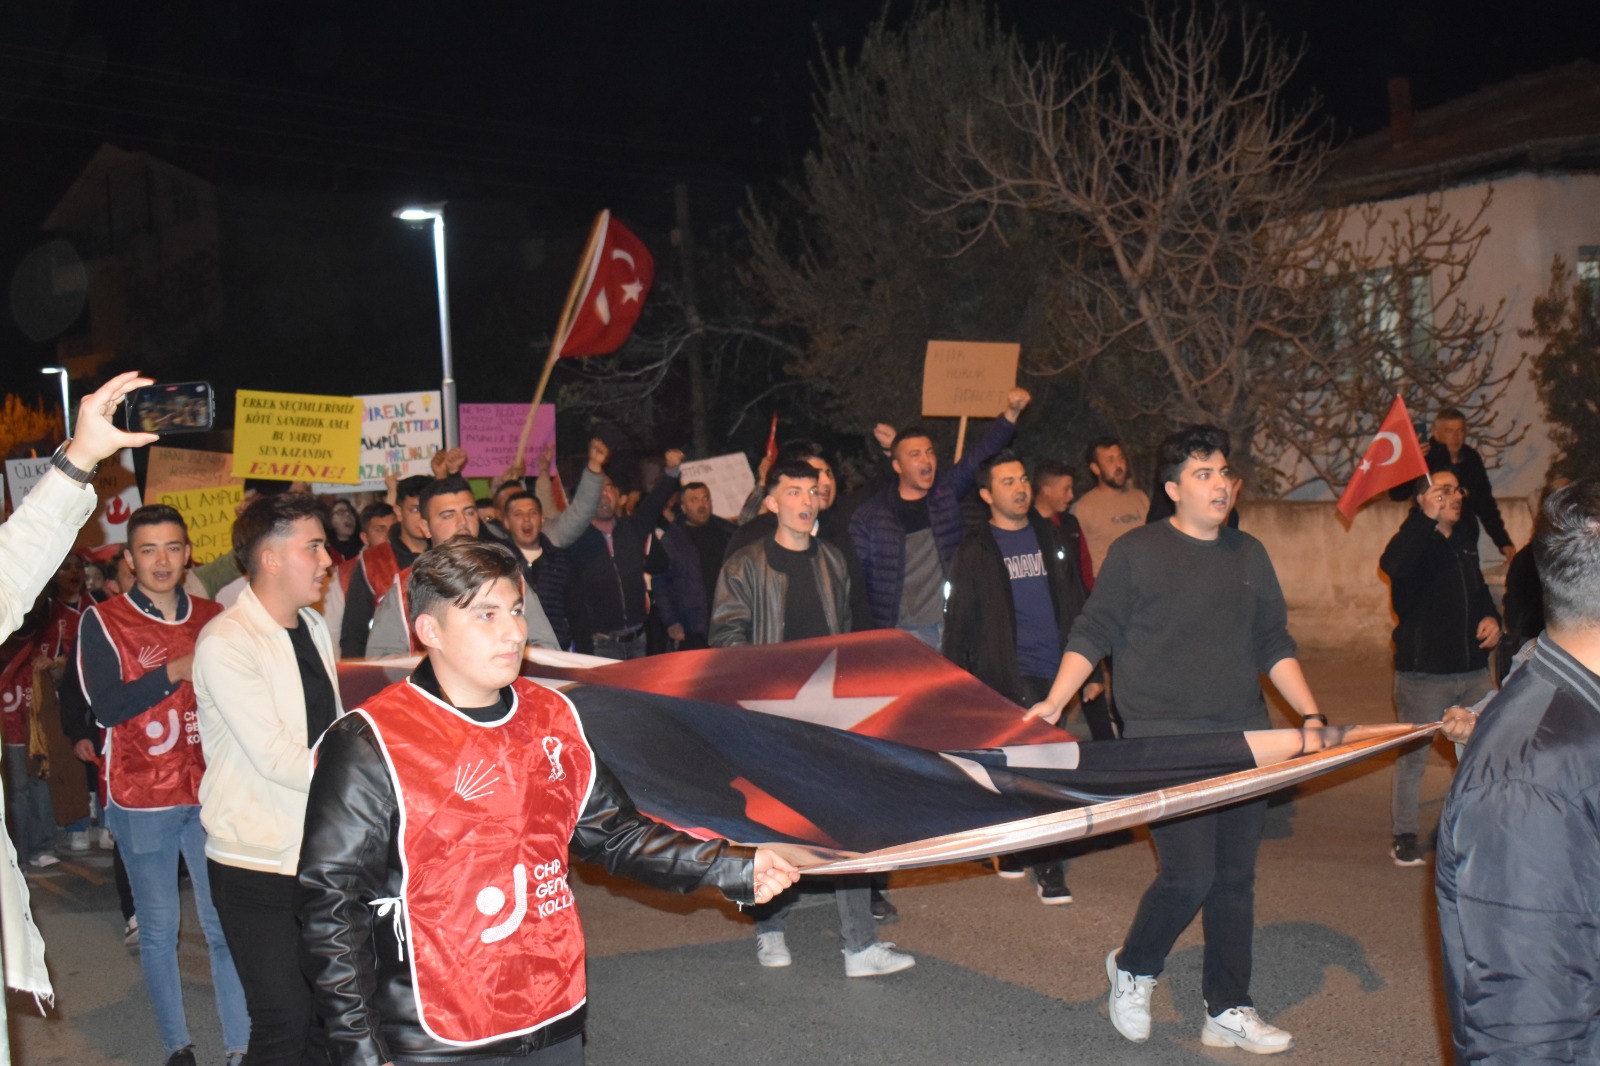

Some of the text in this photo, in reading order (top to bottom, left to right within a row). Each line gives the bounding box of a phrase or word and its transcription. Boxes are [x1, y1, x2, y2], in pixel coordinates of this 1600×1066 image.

[242, 397, 355, 414] ERKEK SEÇİMLERİMİZ
[245, 411, 350, 430] KÖTÜ SANIRDIK AMA
[272, 430, 322, 446] BU YARIŞI
[361, 434, 406, 450] AMPUL
[259, 445, 333, 459] SEN KAZANDIN
[249, 459, 347, 480] EMİNE!
[161, 494, 191, 512] BU
[533, 858, 561, 880] CHP
